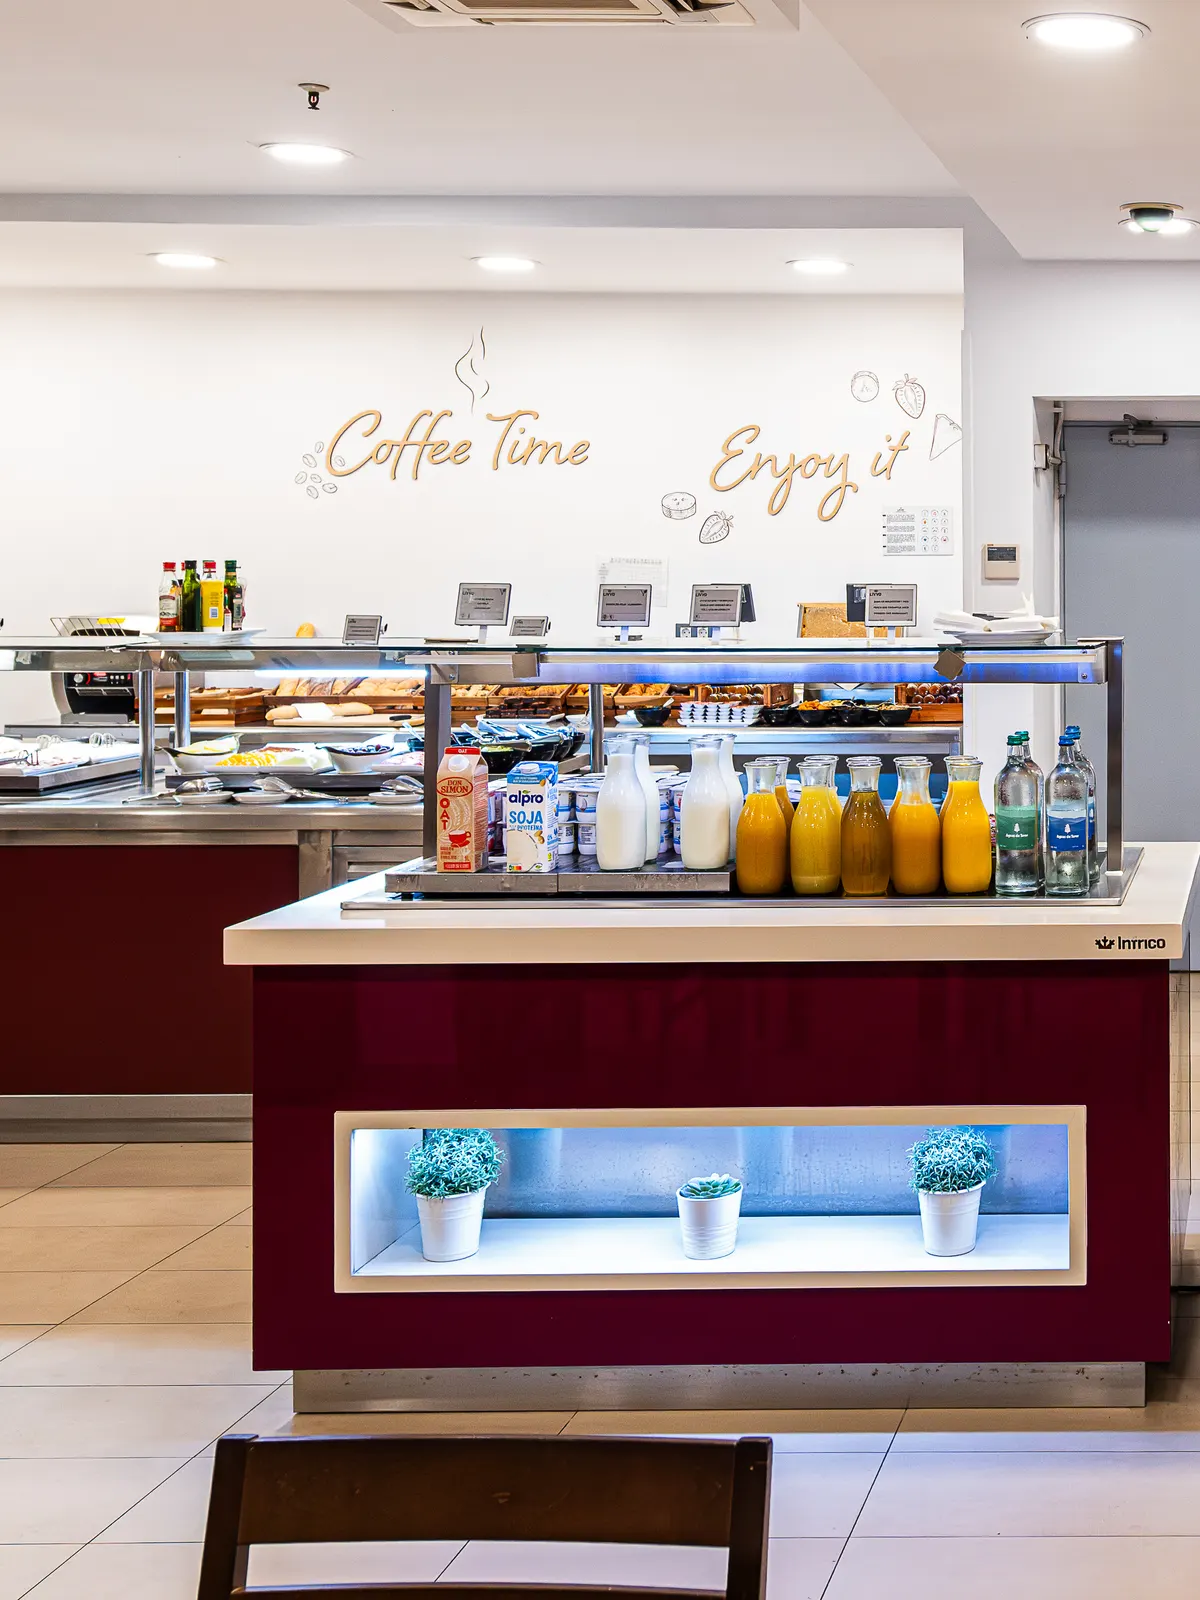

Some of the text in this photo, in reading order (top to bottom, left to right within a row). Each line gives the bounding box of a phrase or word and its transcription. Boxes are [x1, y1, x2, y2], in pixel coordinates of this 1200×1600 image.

[325, 409, 591, 480] Coffee Time
[709, 424, 911, 522] Enjoy it
[440, 785, 469, 794] SIMON
[508, 790, 544, 807] alpro
[439, 797, 451, 831] OAT
[509, 810, 544, 825] SOJA
